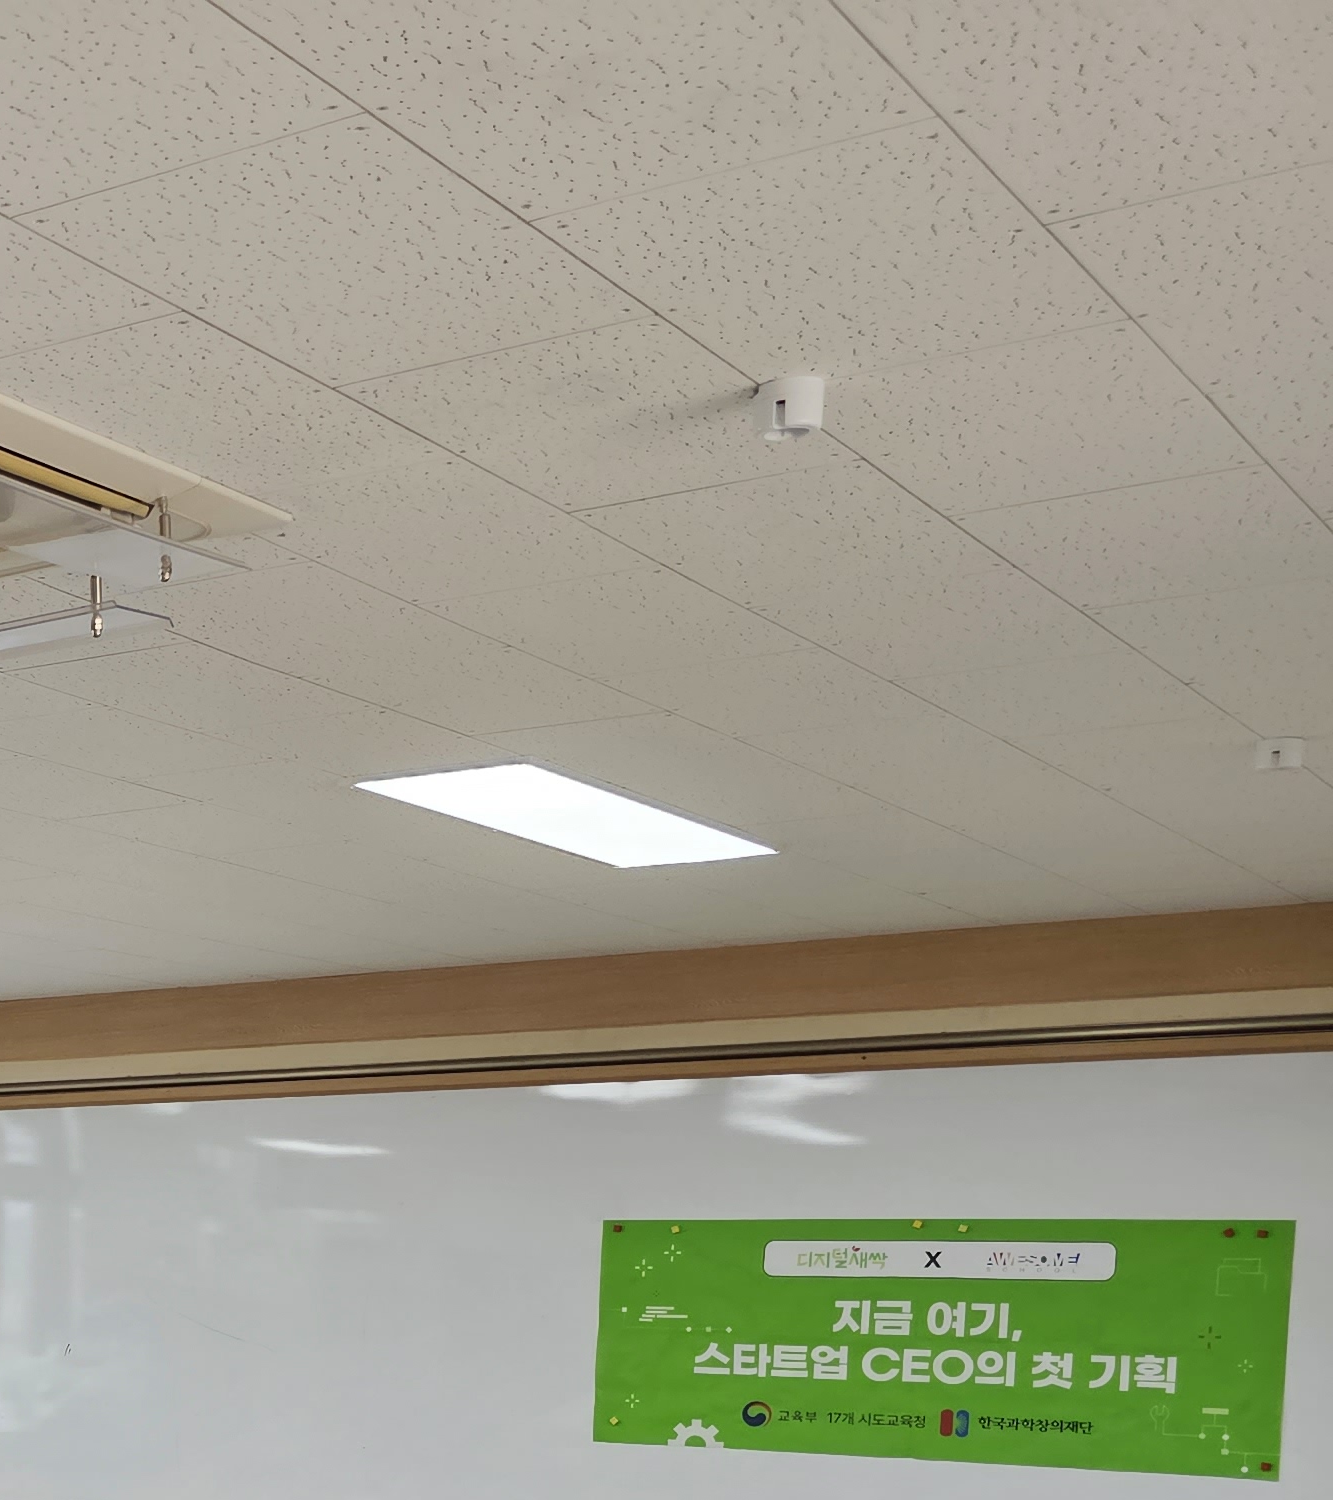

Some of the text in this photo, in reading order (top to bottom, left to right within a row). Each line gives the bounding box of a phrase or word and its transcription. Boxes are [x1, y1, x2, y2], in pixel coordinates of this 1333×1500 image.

[796, 1247, 889, 1269] 디지털새싹
[924, 1250, 942, 1269] X
[832, 1300, 1023, 1343] 지금 여기,
[693, 1341, 1178, 1394] 스타트업 CEO의 첫 기획
[778, 1410, 926, 1429] 교육부 17개 시도교육청
[978, 1415, 1095, 1436] 한국과학창의재단
